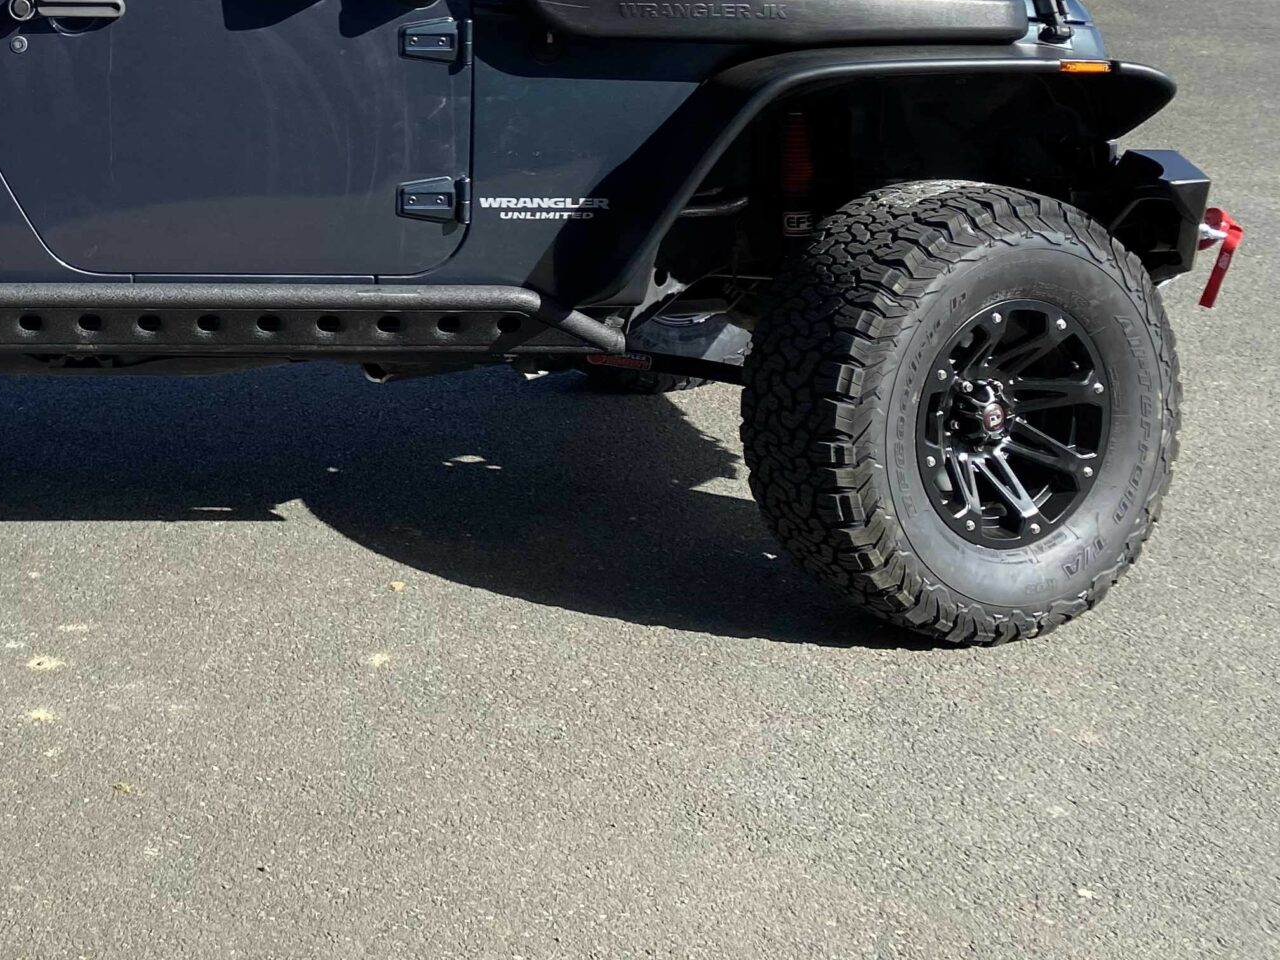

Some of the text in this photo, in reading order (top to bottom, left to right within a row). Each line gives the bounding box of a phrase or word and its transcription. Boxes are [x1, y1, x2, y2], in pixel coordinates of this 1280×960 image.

[619, 2, 788, 19] WRANGLER JK
[479, 197, 610, 209] WRANGLER
[500, 211, 595, 220] UNLIMITED
